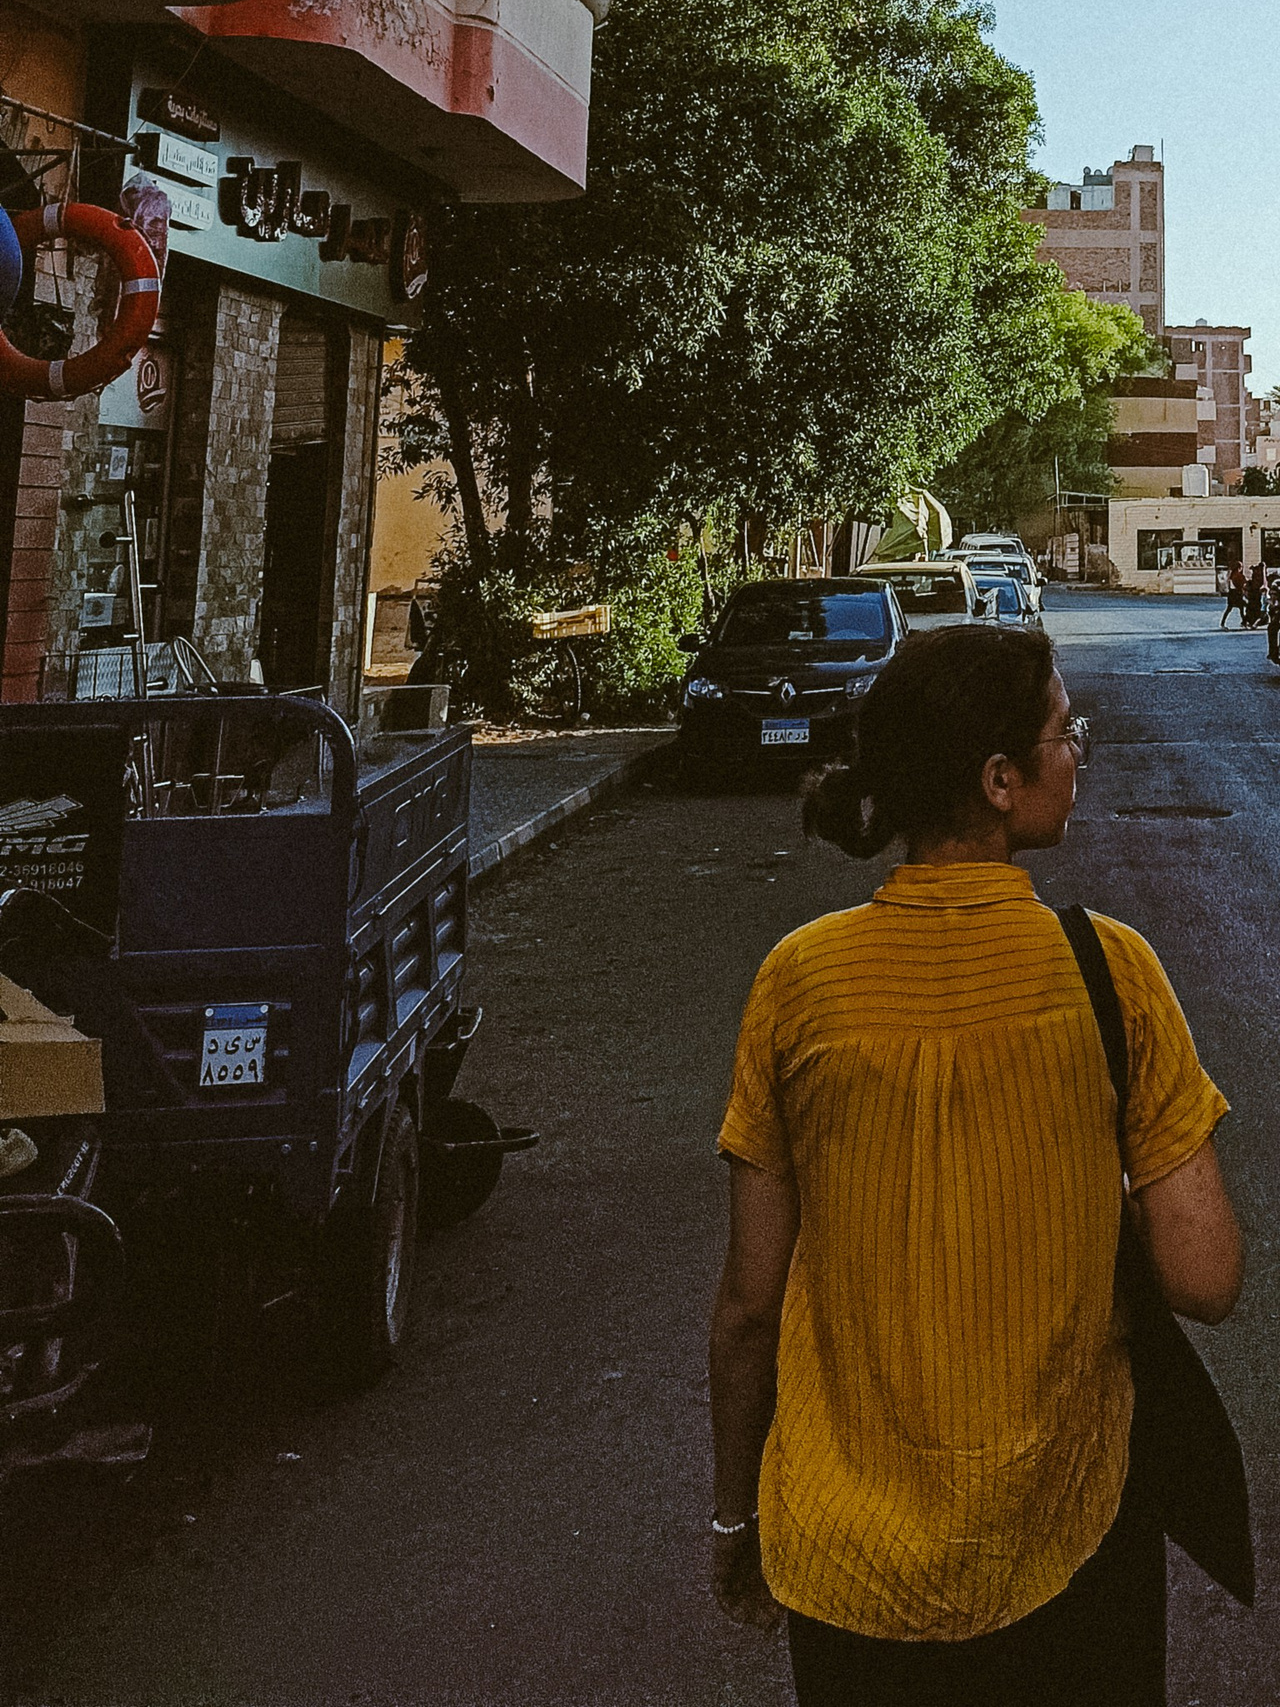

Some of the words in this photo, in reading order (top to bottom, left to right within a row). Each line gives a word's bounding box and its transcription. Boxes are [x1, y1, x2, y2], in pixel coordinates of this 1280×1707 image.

[207, 1038, 219, 1055] د
[244, 1036, 261, 1053] س
[203, 1058, 259, 1084] ٨٥٥٩
